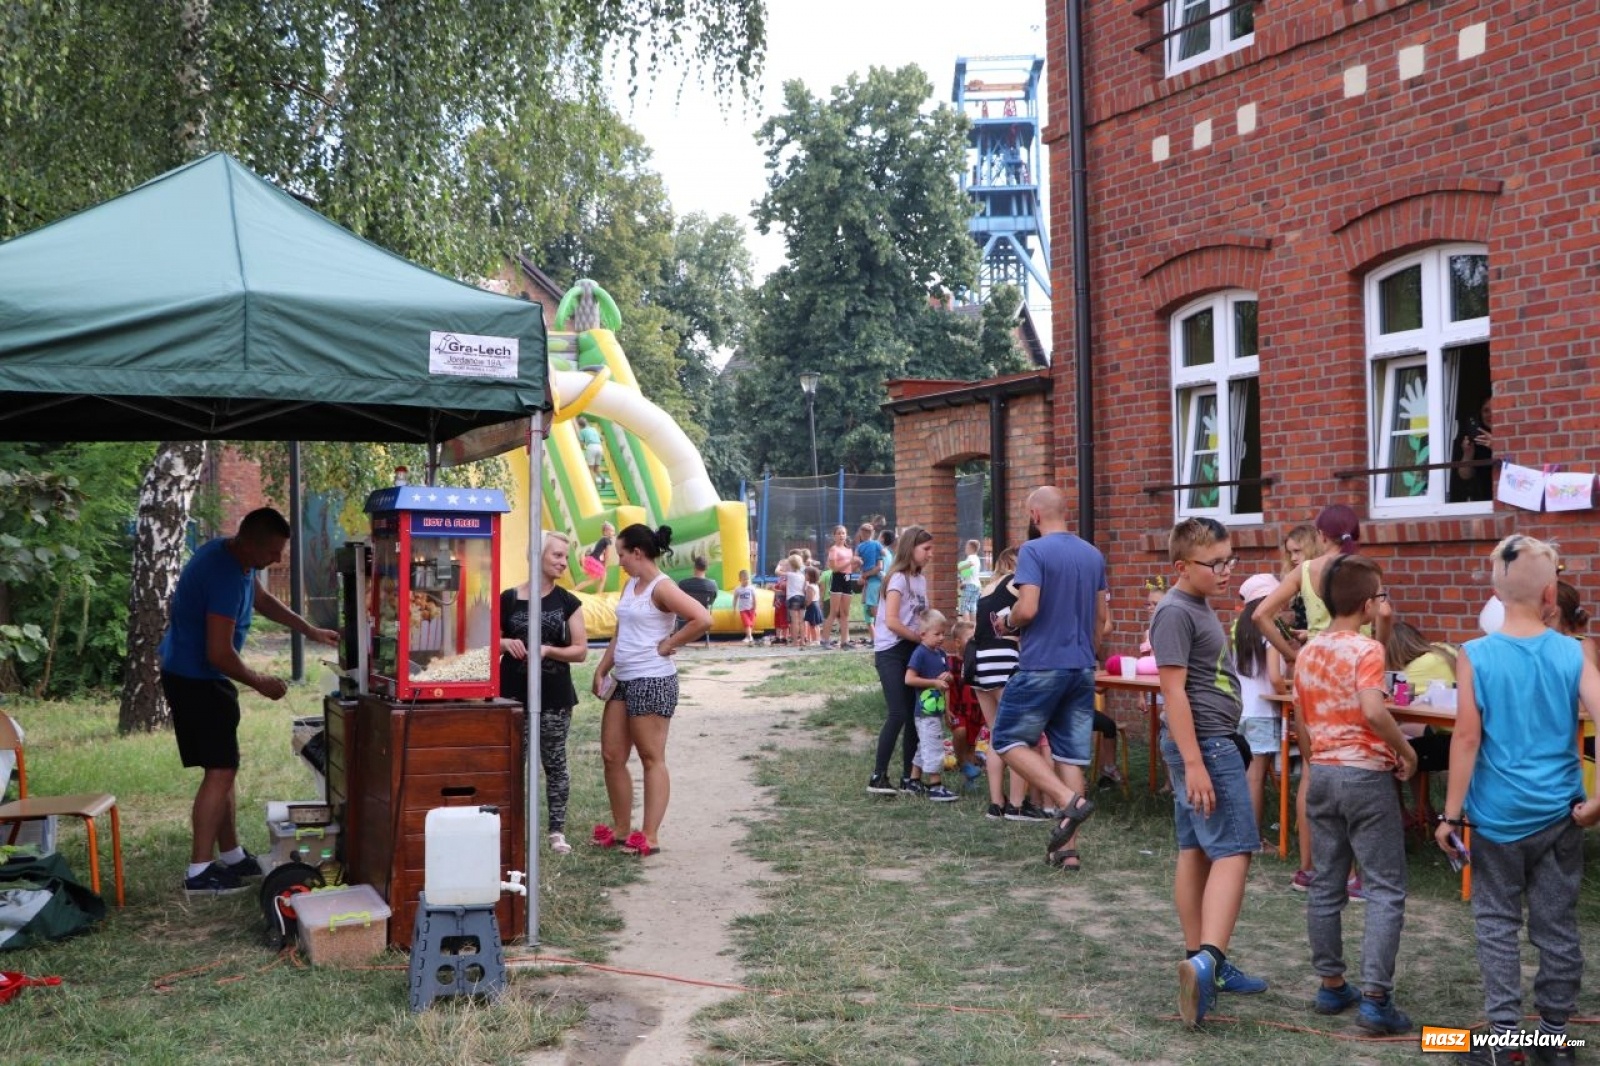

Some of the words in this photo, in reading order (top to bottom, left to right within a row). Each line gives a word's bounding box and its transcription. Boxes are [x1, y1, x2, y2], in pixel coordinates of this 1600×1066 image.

[448, 341, 511, 356] Gra-Lech
[423, 517, 443, 527] HOT
[444, 518, 452, 527] &
[453, 518, 480, 528] FRESH
